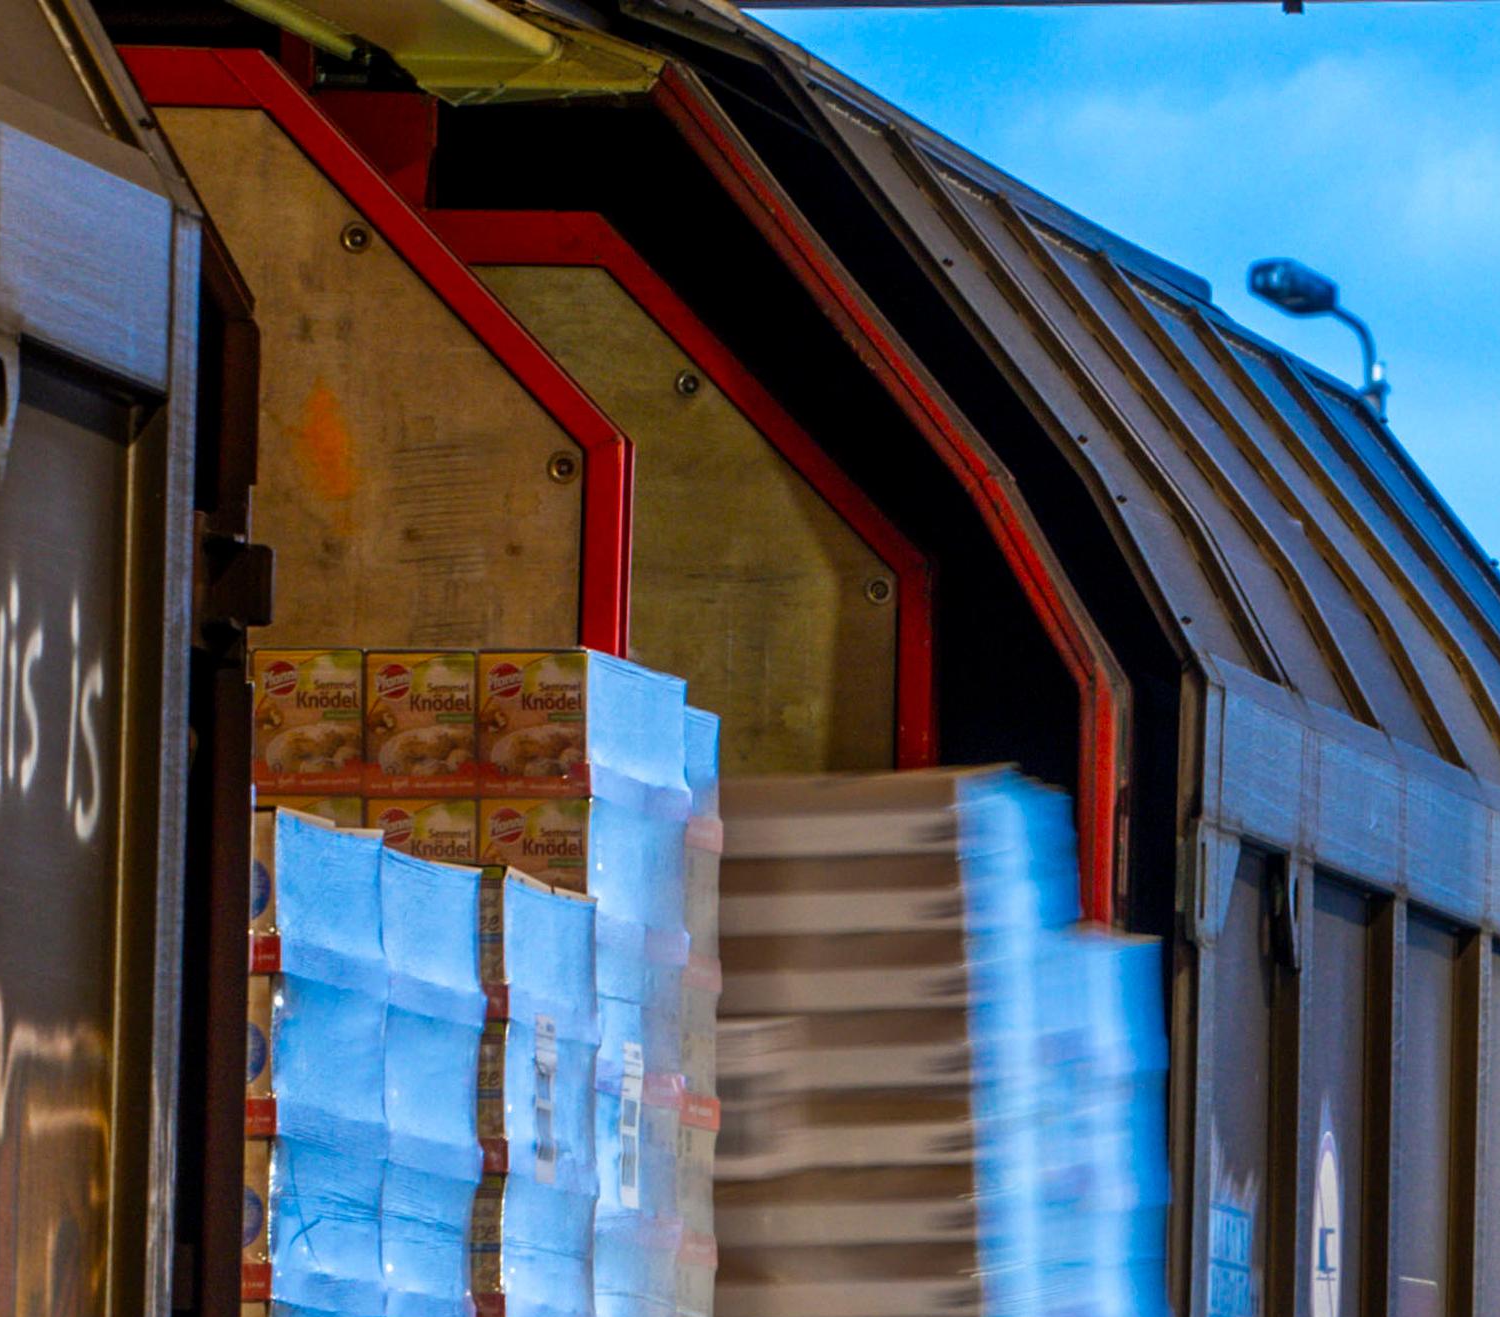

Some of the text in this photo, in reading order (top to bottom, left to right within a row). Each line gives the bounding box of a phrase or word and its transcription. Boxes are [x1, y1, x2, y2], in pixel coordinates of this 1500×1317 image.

[296, 690, 360, 709] Knödel
[409, 693, 472, 712] Knödel
[521, 692, 582, 711] Knödel
[410, 839, 474, 858] Knödel
[522, 838, 583, 857] Knödel
